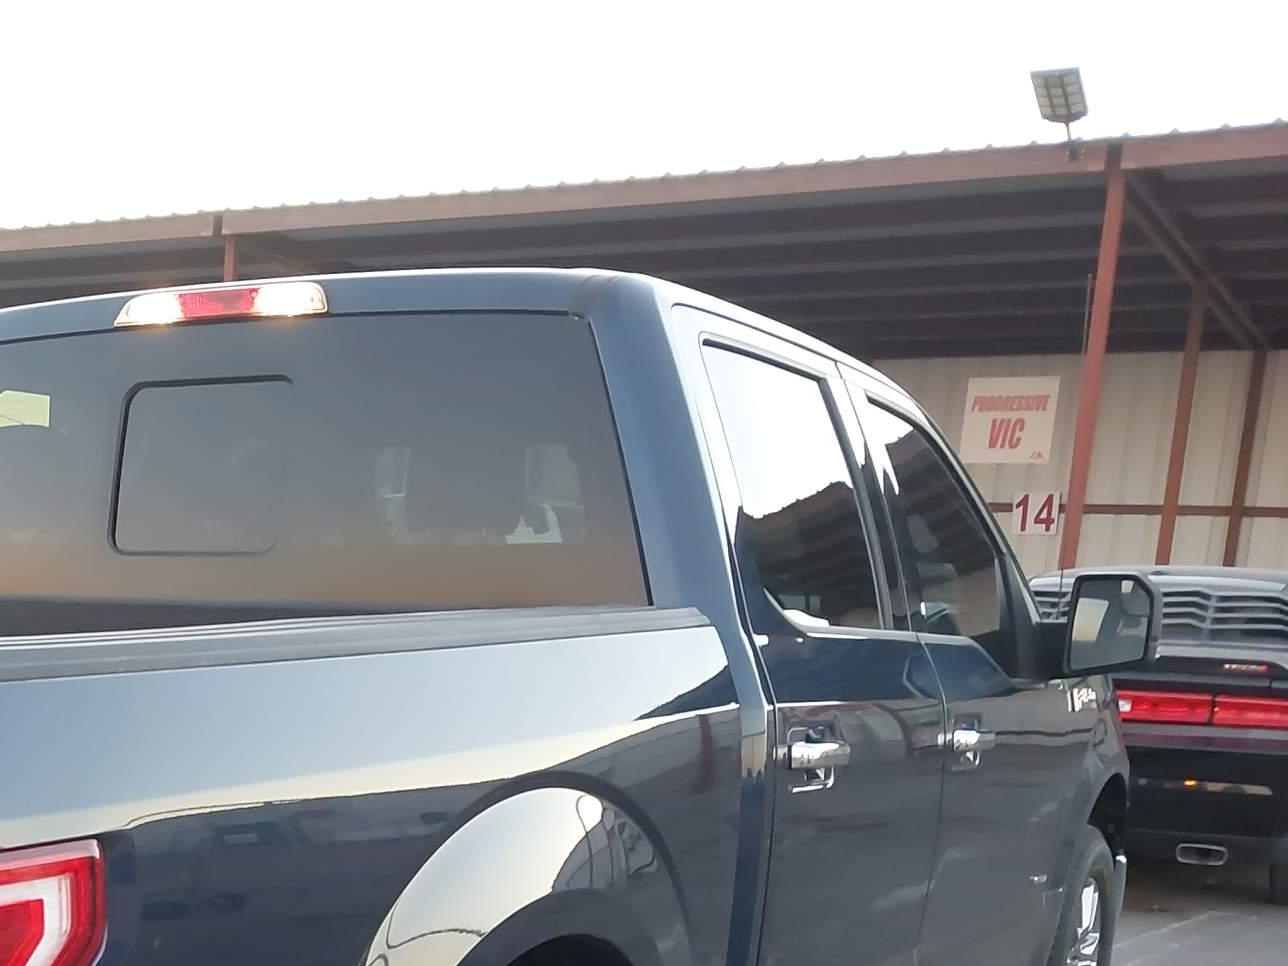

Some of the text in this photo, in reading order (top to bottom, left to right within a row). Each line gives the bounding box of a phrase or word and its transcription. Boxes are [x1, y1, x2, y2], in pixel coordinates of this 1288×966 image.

[971, 394, 1051, 413] PROGRESSIVE
[988, 417, 1026, 450] VIC
[1015, 494, 1055, 532] 14
